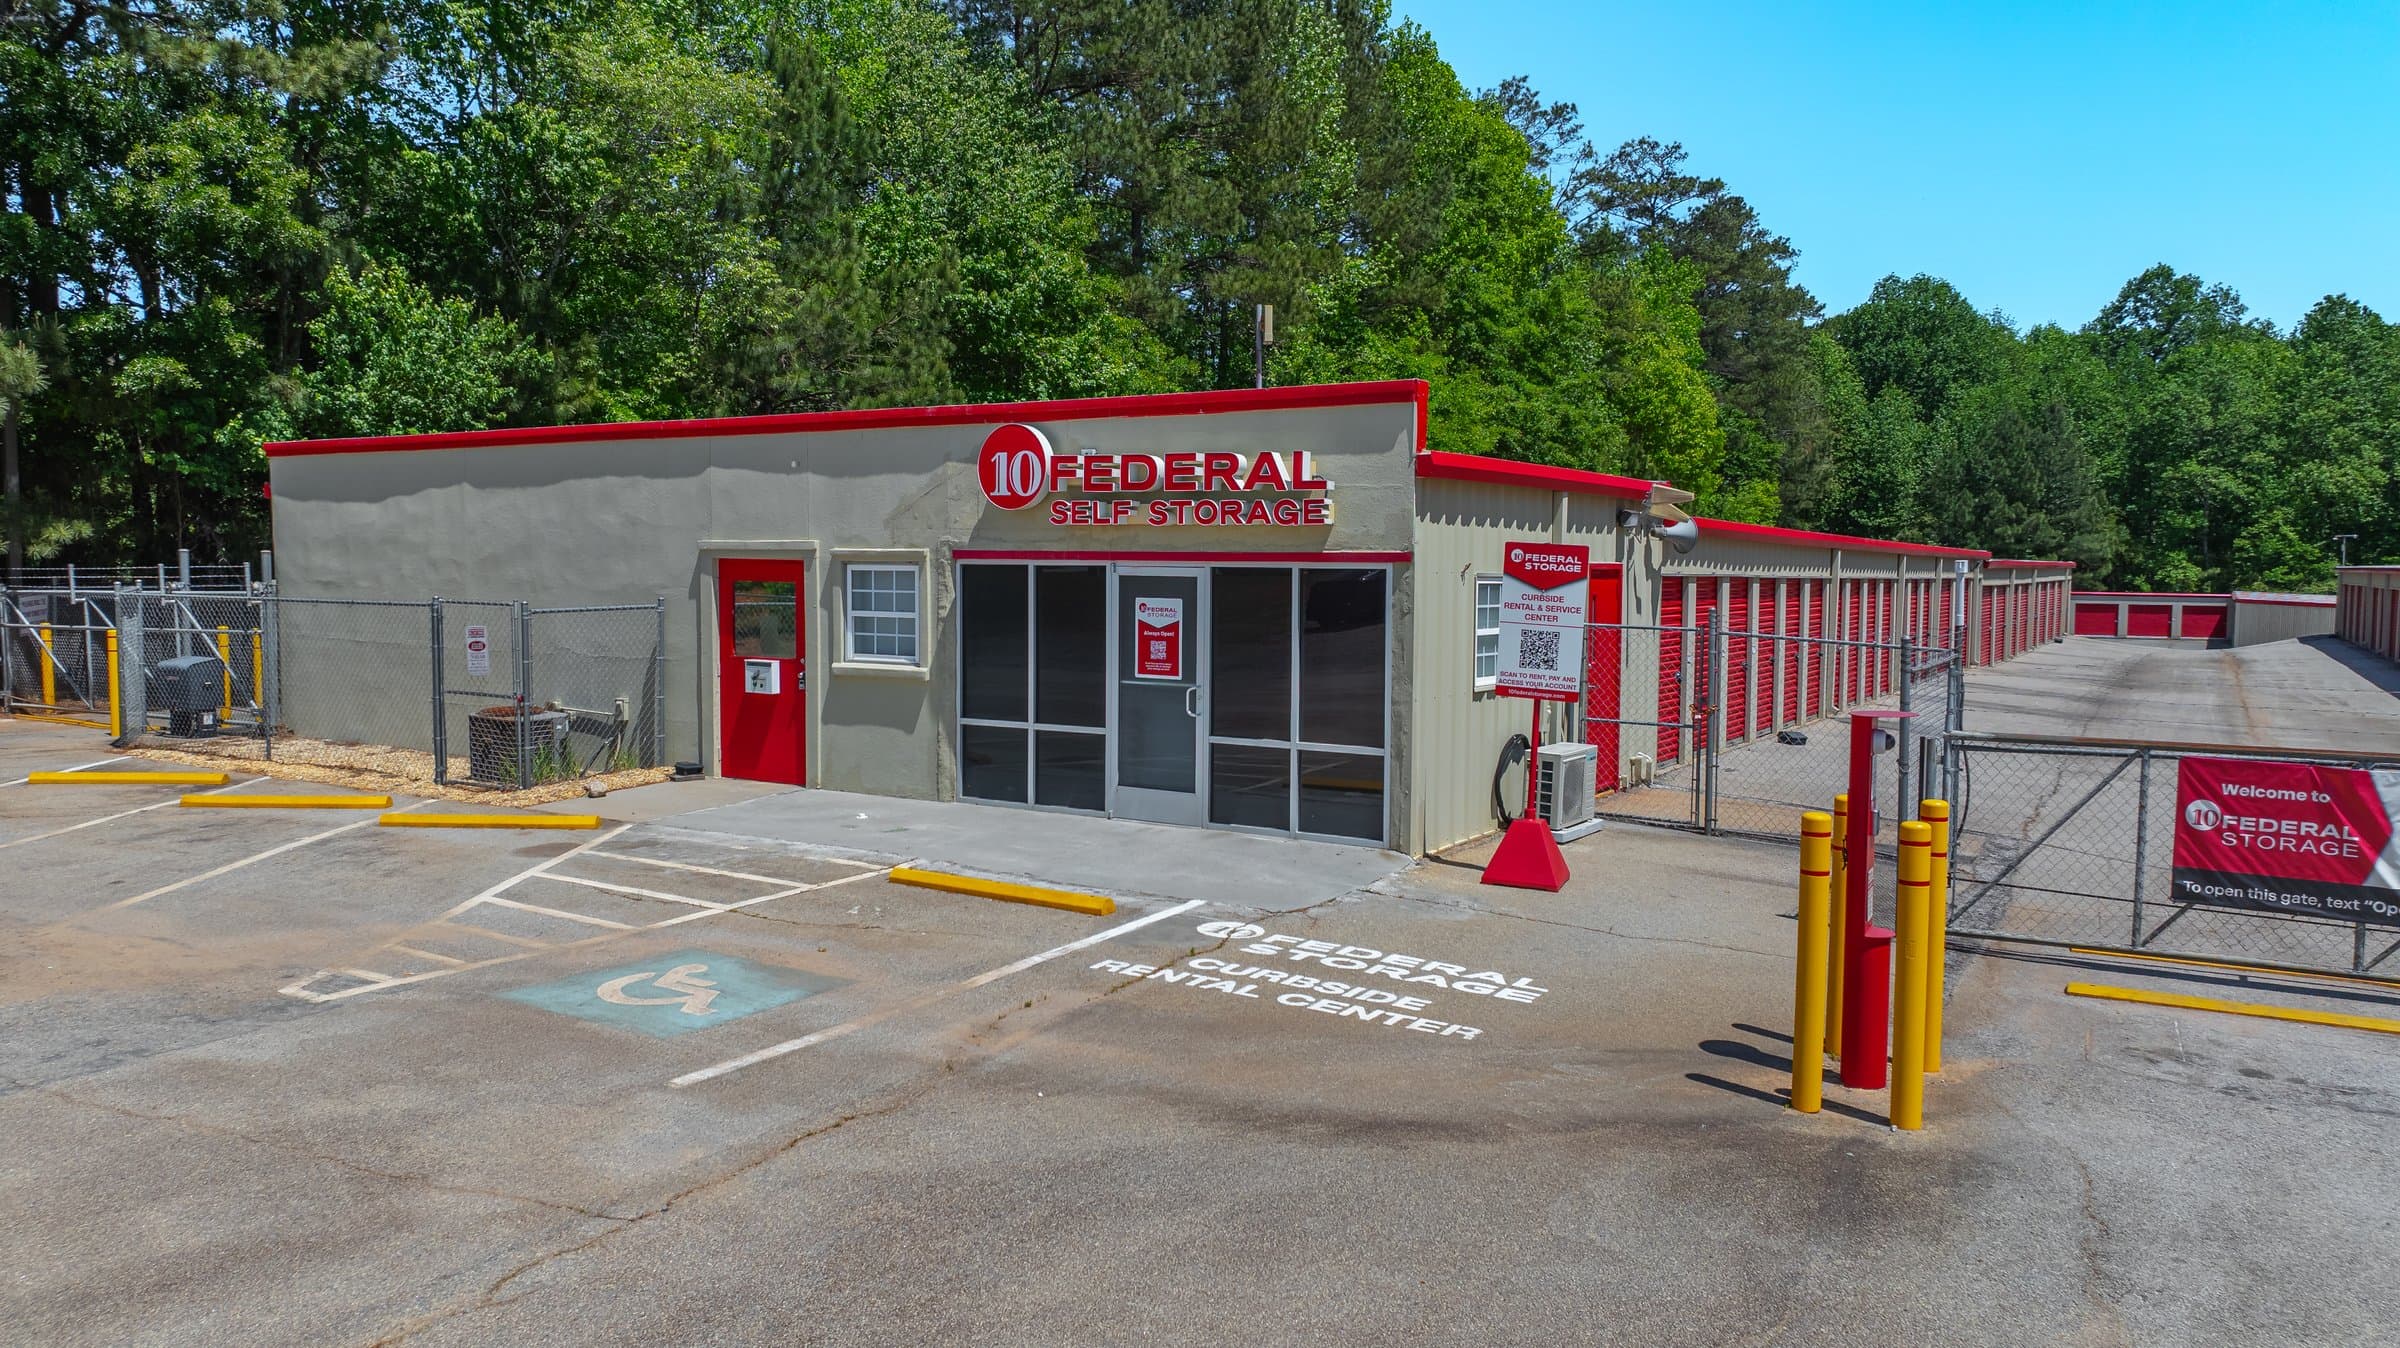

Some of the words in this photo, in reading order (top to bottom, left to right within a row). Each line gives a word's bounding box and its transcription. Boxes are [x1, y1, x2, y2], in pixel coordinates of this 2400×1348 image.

[989, 449, 1041, 497] 10
[1049, 451, 1329, 493] FEDERAL
[1049, 499, 1134, 526] SELF
[1147, 498, 1327, 526] STORAGE
[1525, 553, 1582, 564] FEDERAL
[1525, 562, 1582, 573] STORAGE
[1504, 602, 1535, 611] RENTAL
[1537, 604, 1543, 612] &
[1545, 605, 1582, 614] SERVICE
[1521, 593, 1565, 603] CURBSIDE
[1525, 614, 1559, 622] CENTER
[1499, 678, 1524, 686] ACCESS
[1545, 683, 1577, 691] ACCOUNT
[2221, 783, 2307, 802] Welcome
[2311, 790, 2331, 803] to
[2192, 808, 2218, 826] 10
[2222, 815, 2359, 841] FEDERAL
[2221, 832, 2359, 858] STORAGE
[2183, 880, 2201, 893] To
[2204, 885, 2243, 899] open
[2248, 887, 2277, 902] this
[2280, 891, 2322, 908] gate,
[2326, 896, 2360, 911] text
[1240, 943, 1546, 1004] STORAGE
[1263, 934, 1549, 993] FEDERAL
[1187, 958, 1433, 1012] CURBSIDE
[1089, 959, 1260, 999] RENTAL
[1276, 993, 1484, 1041] CENTER
